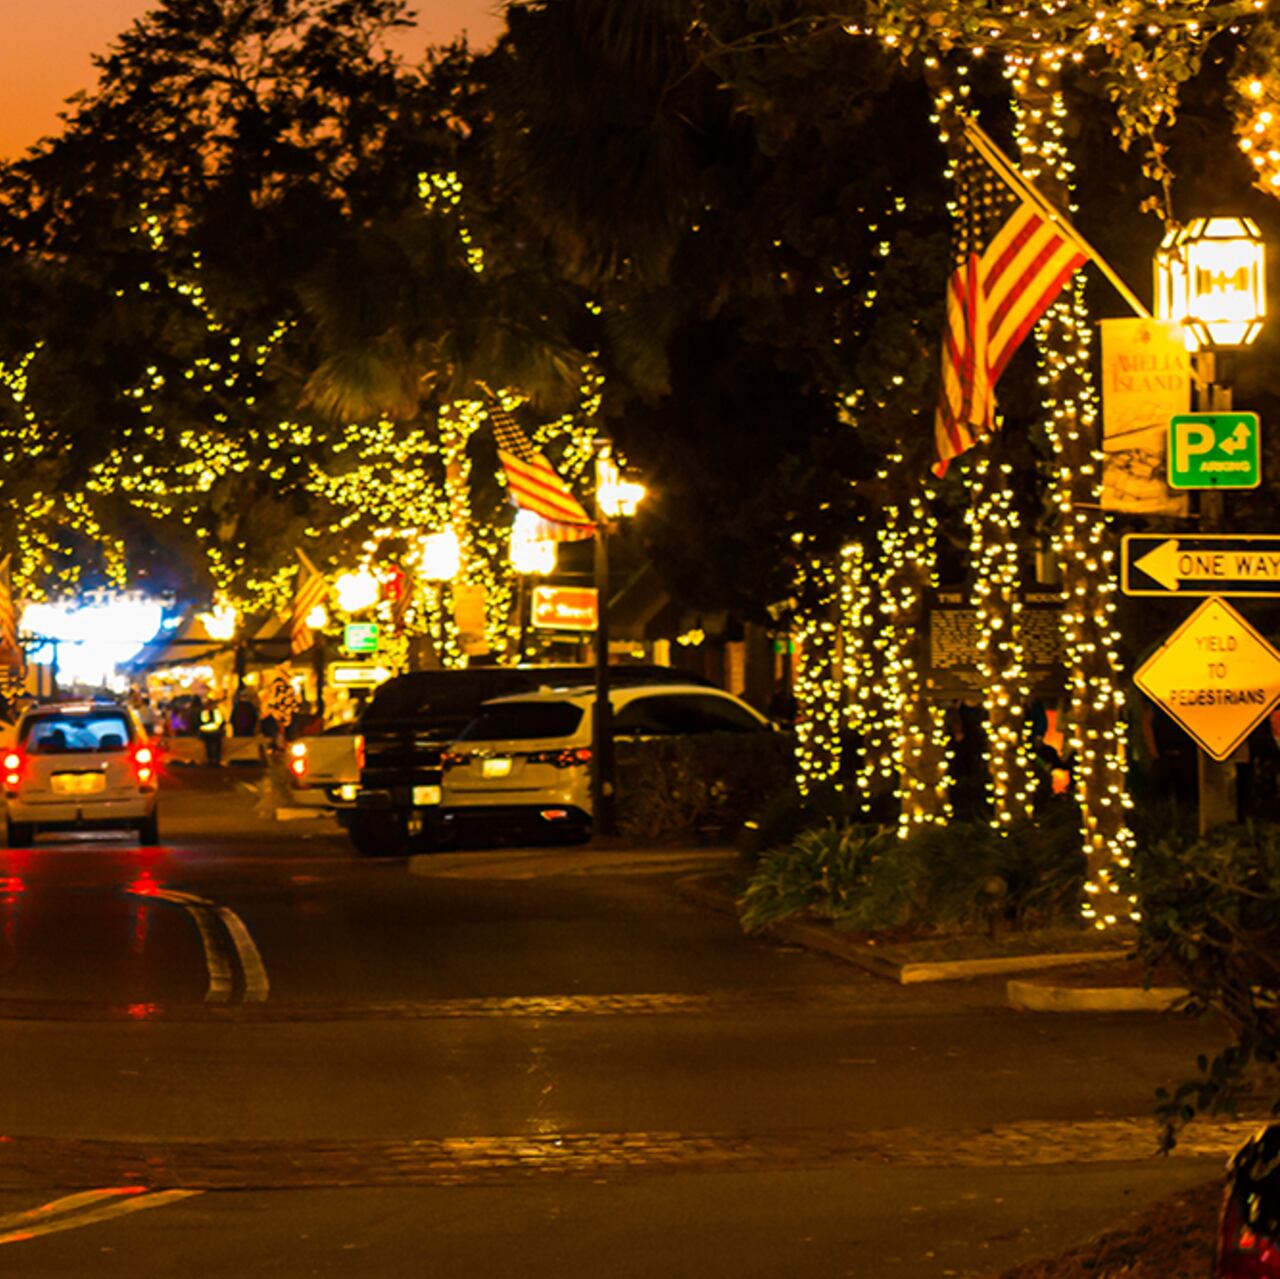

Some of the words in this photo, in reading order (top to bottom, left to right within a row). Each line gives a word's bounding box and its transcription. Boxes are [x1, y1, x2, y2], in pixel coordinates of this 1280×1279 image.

[1179, 554, 1225, 576] ONE
[1237, 555, 1280, 576] WAY
[1195, 635, 1237, 652] YIELD
[1208, 663, 1226, 679] TO
[1169, 689, 1265, 706] PEDESTRIANS
